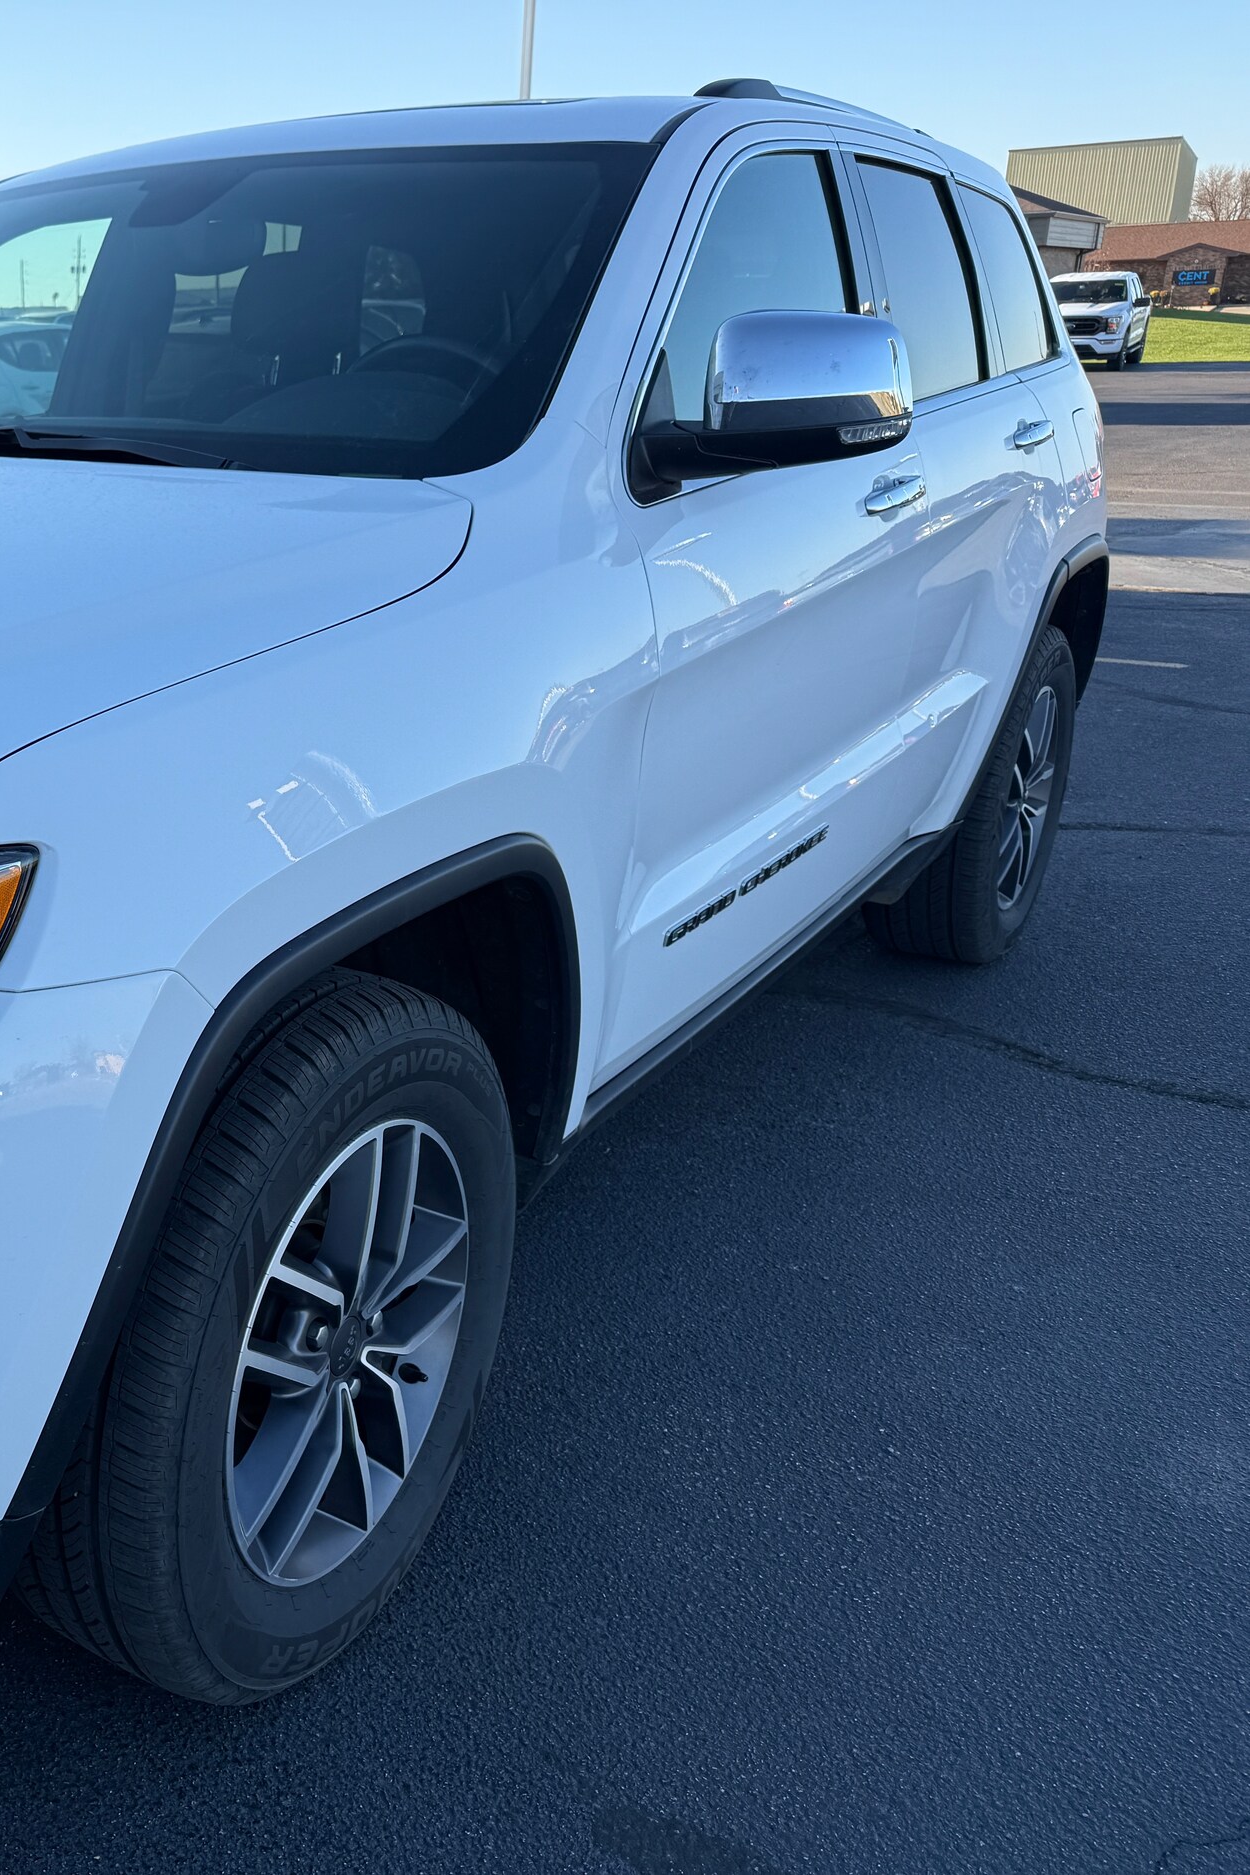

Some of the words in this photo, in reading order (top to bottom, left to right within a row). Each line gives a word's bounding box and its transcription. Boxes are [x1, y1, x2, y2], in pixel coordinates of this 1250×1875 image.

[662, 887, 737, 948] GRAND
[738, 822, 830, 897] CHEROKEE
[296, 1048, 463, 1176] ENDEAVOR
[466, 1061, 492, 1097] PLUS
